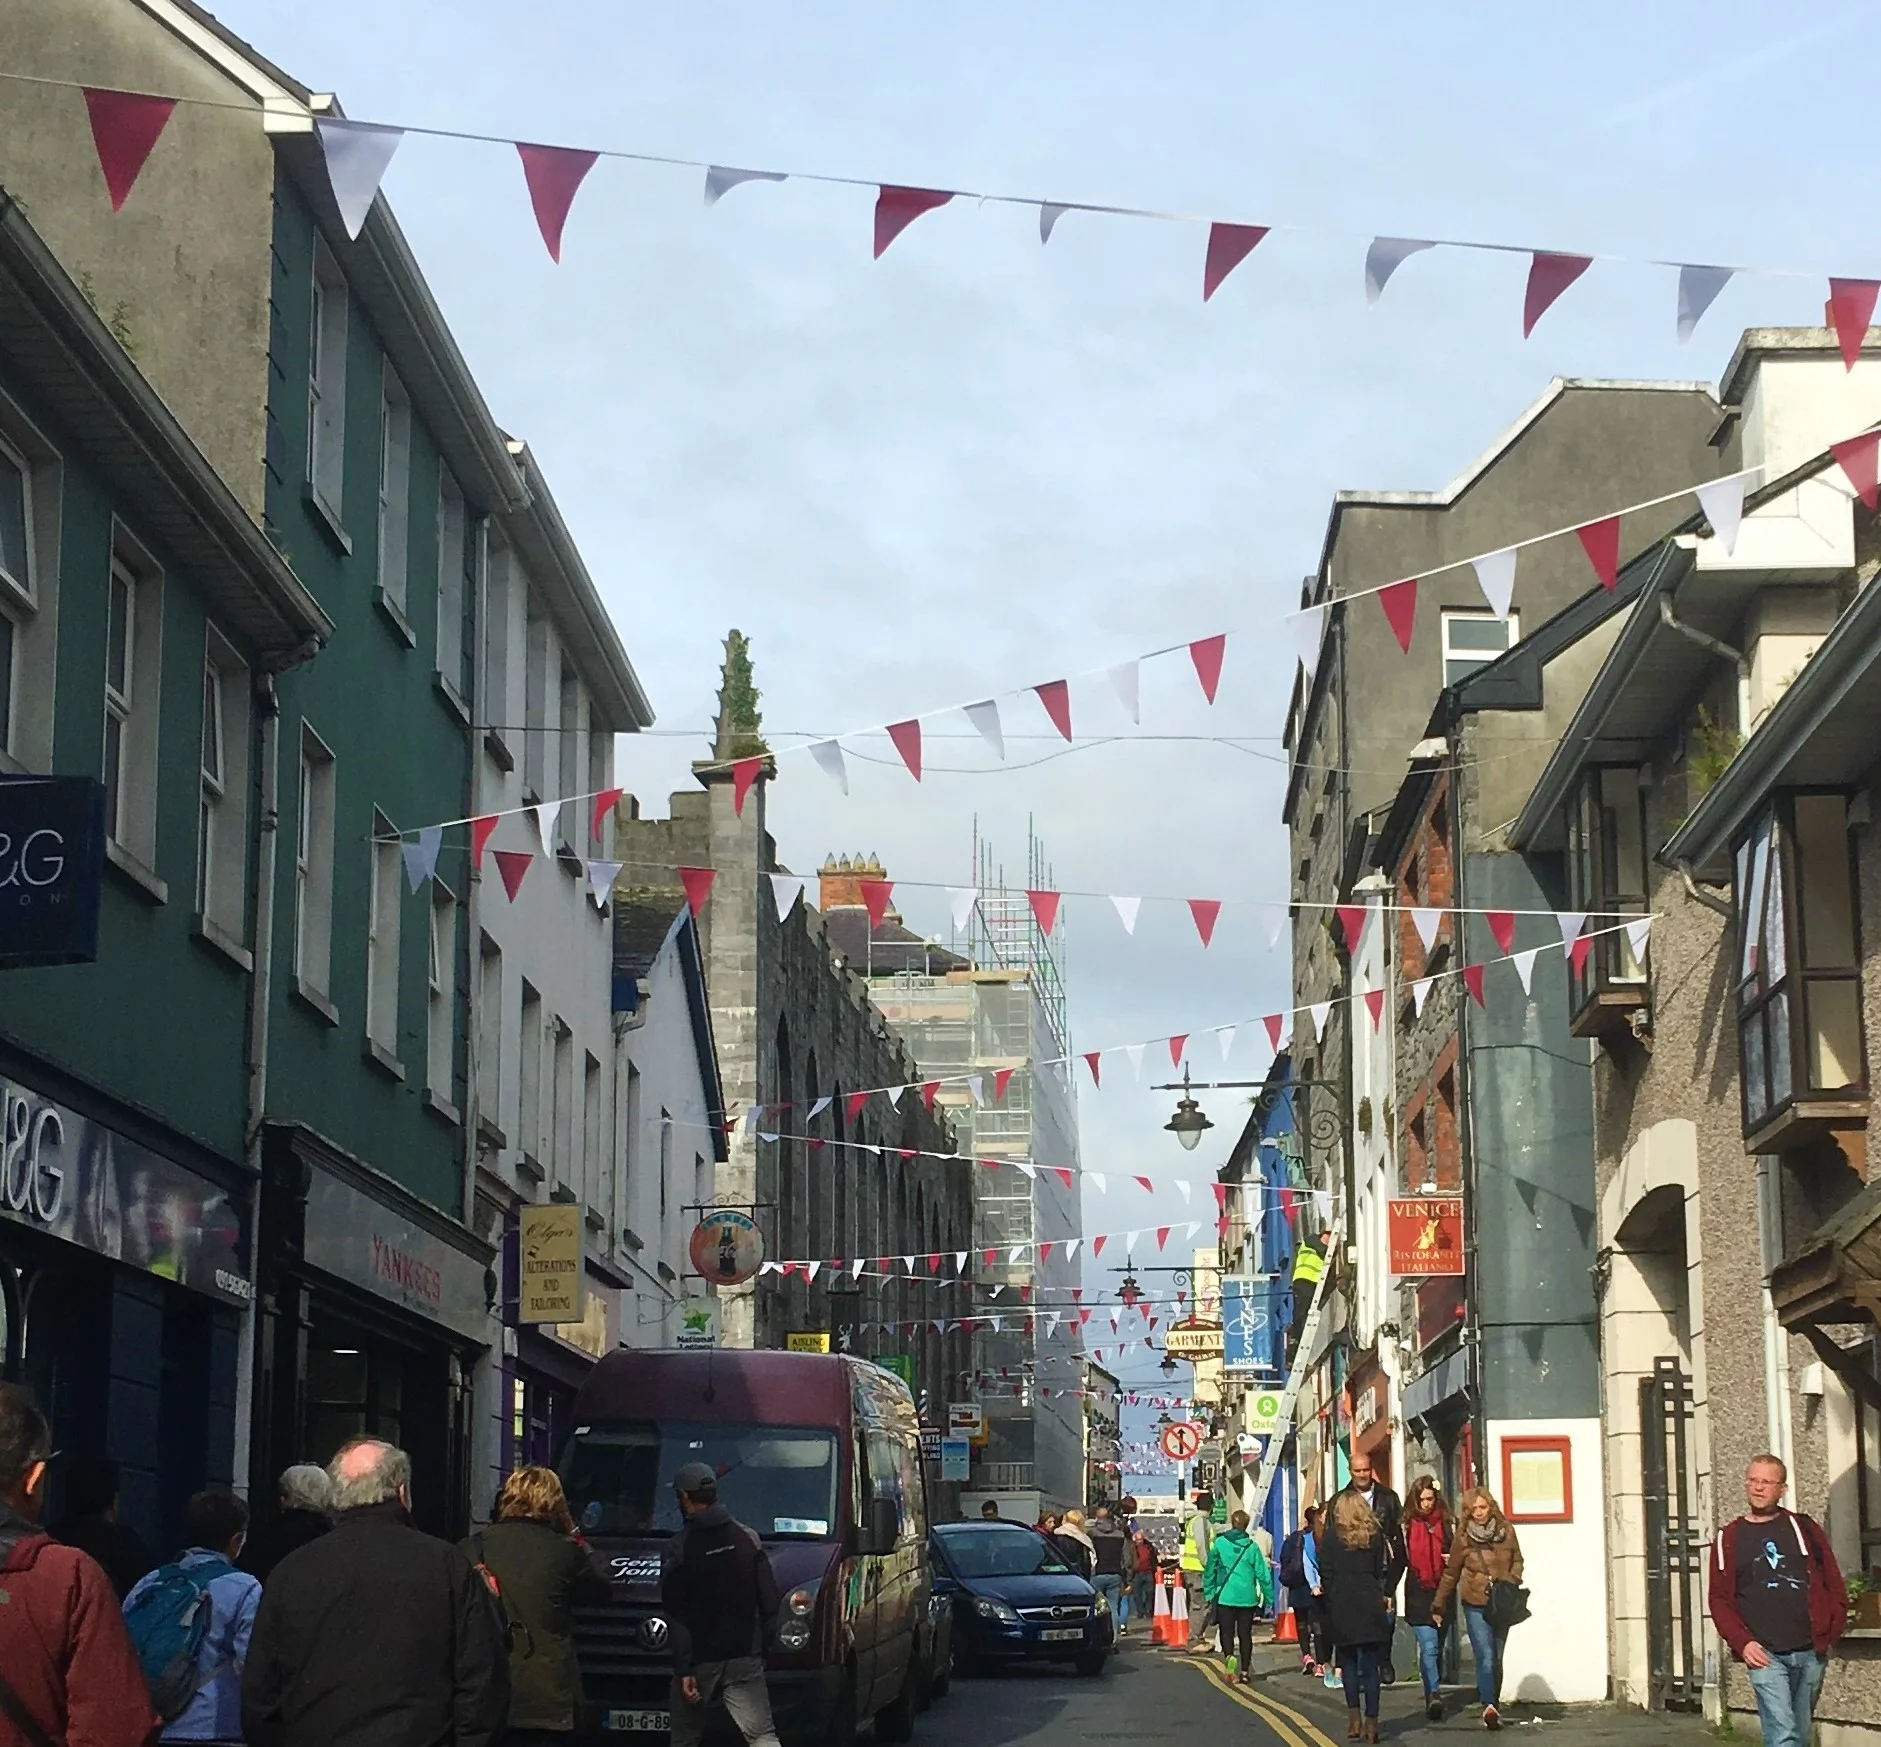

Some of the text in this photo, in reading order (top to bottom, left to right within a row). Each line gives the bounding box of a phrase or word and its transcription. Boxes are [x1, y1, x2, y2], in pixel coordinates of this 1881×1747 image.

[1392, 1202, 1460, 1218] VENICE
[1392, 1250, 1460, 1260] RISTORANTE
[371, 1232, 440, 1301] YANKEES
[526, 1259, 577, 1273] ALTERATIONS
[1401, 1262, 1454, 1273] ITALIANO
[543, 1279, 560, 1292] AND
[530, 1296, 571, 1311] TAILORING
[1239, 1281, 1255, 1356] HYNES
[676, 1335, 716, 1344] National
[1166, 1333, 1221, 1346] GARMENT
[1232, 1356, 1265, 1366] SHOES
[1251, 1419, 1277, 1429] Oxfa
